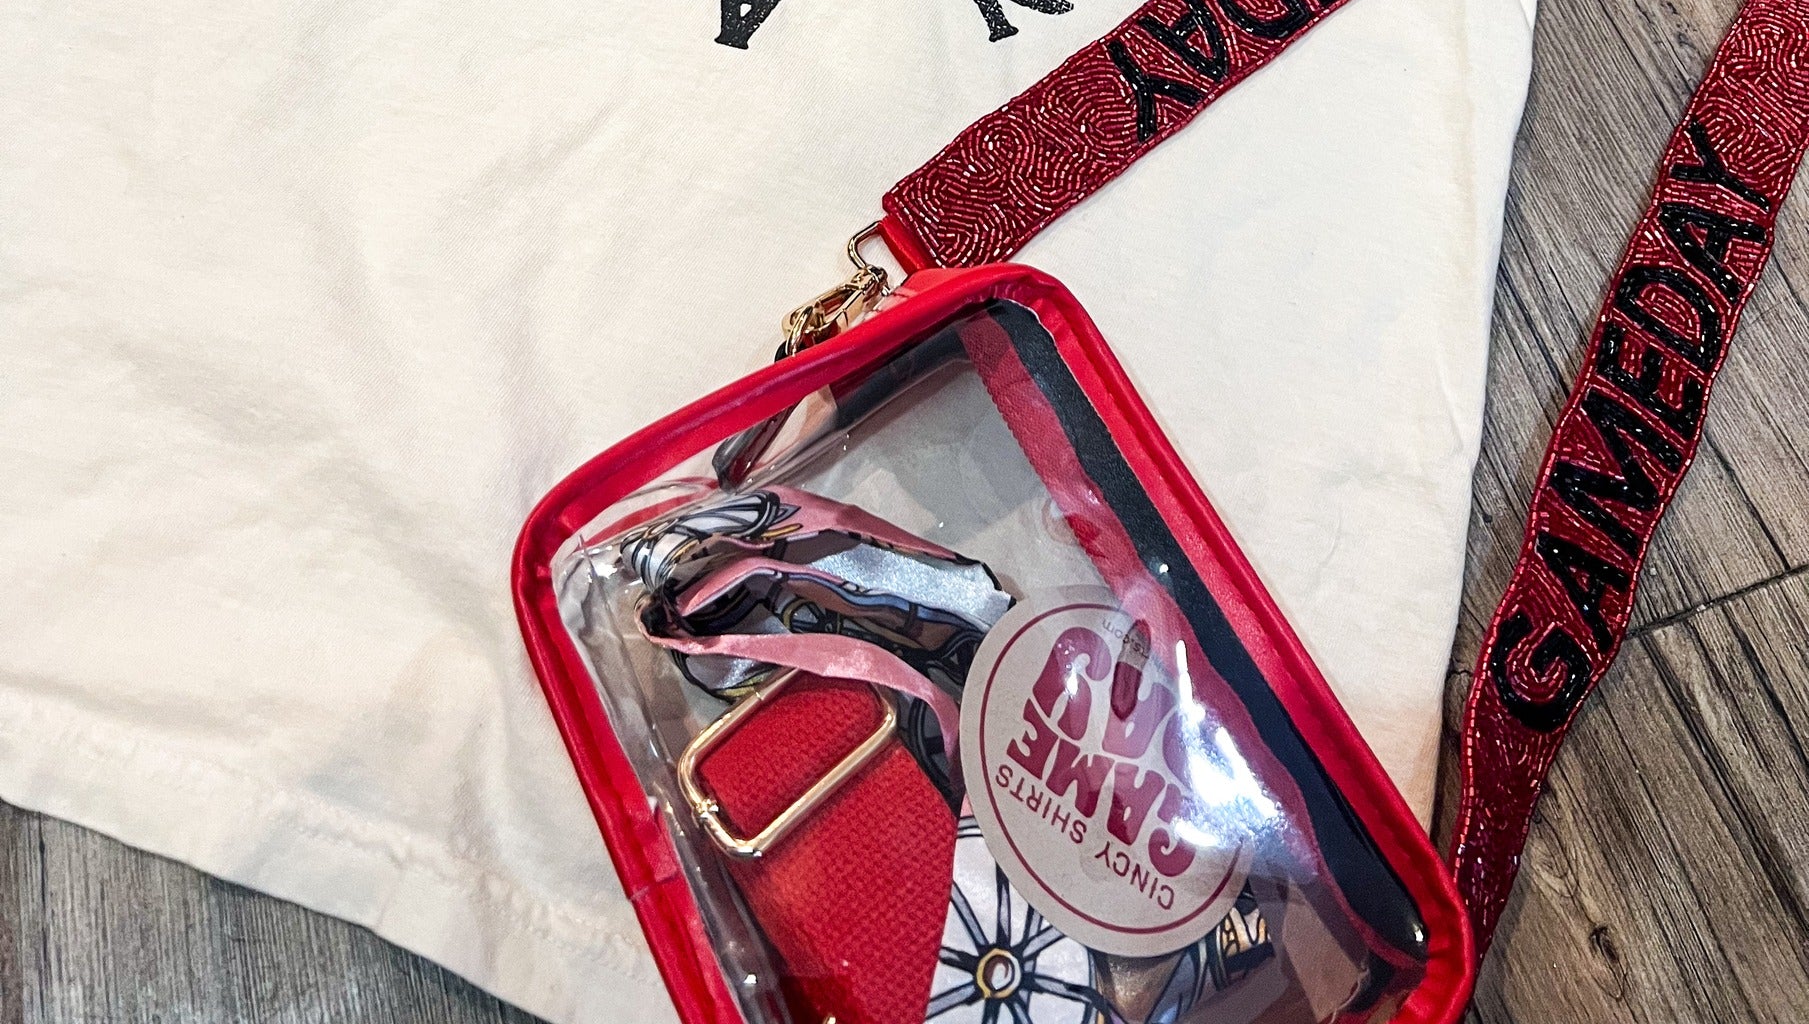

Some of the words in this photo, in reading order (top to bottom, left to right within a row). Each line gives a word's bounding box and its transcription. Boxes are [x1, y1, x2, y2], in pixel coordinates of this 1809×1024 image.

[1494, 119, 1773, 732] GAMEDAY
[995, 764, 1087, 844] SHIRTS
[1095, 840, 1175, 910] CINCY
